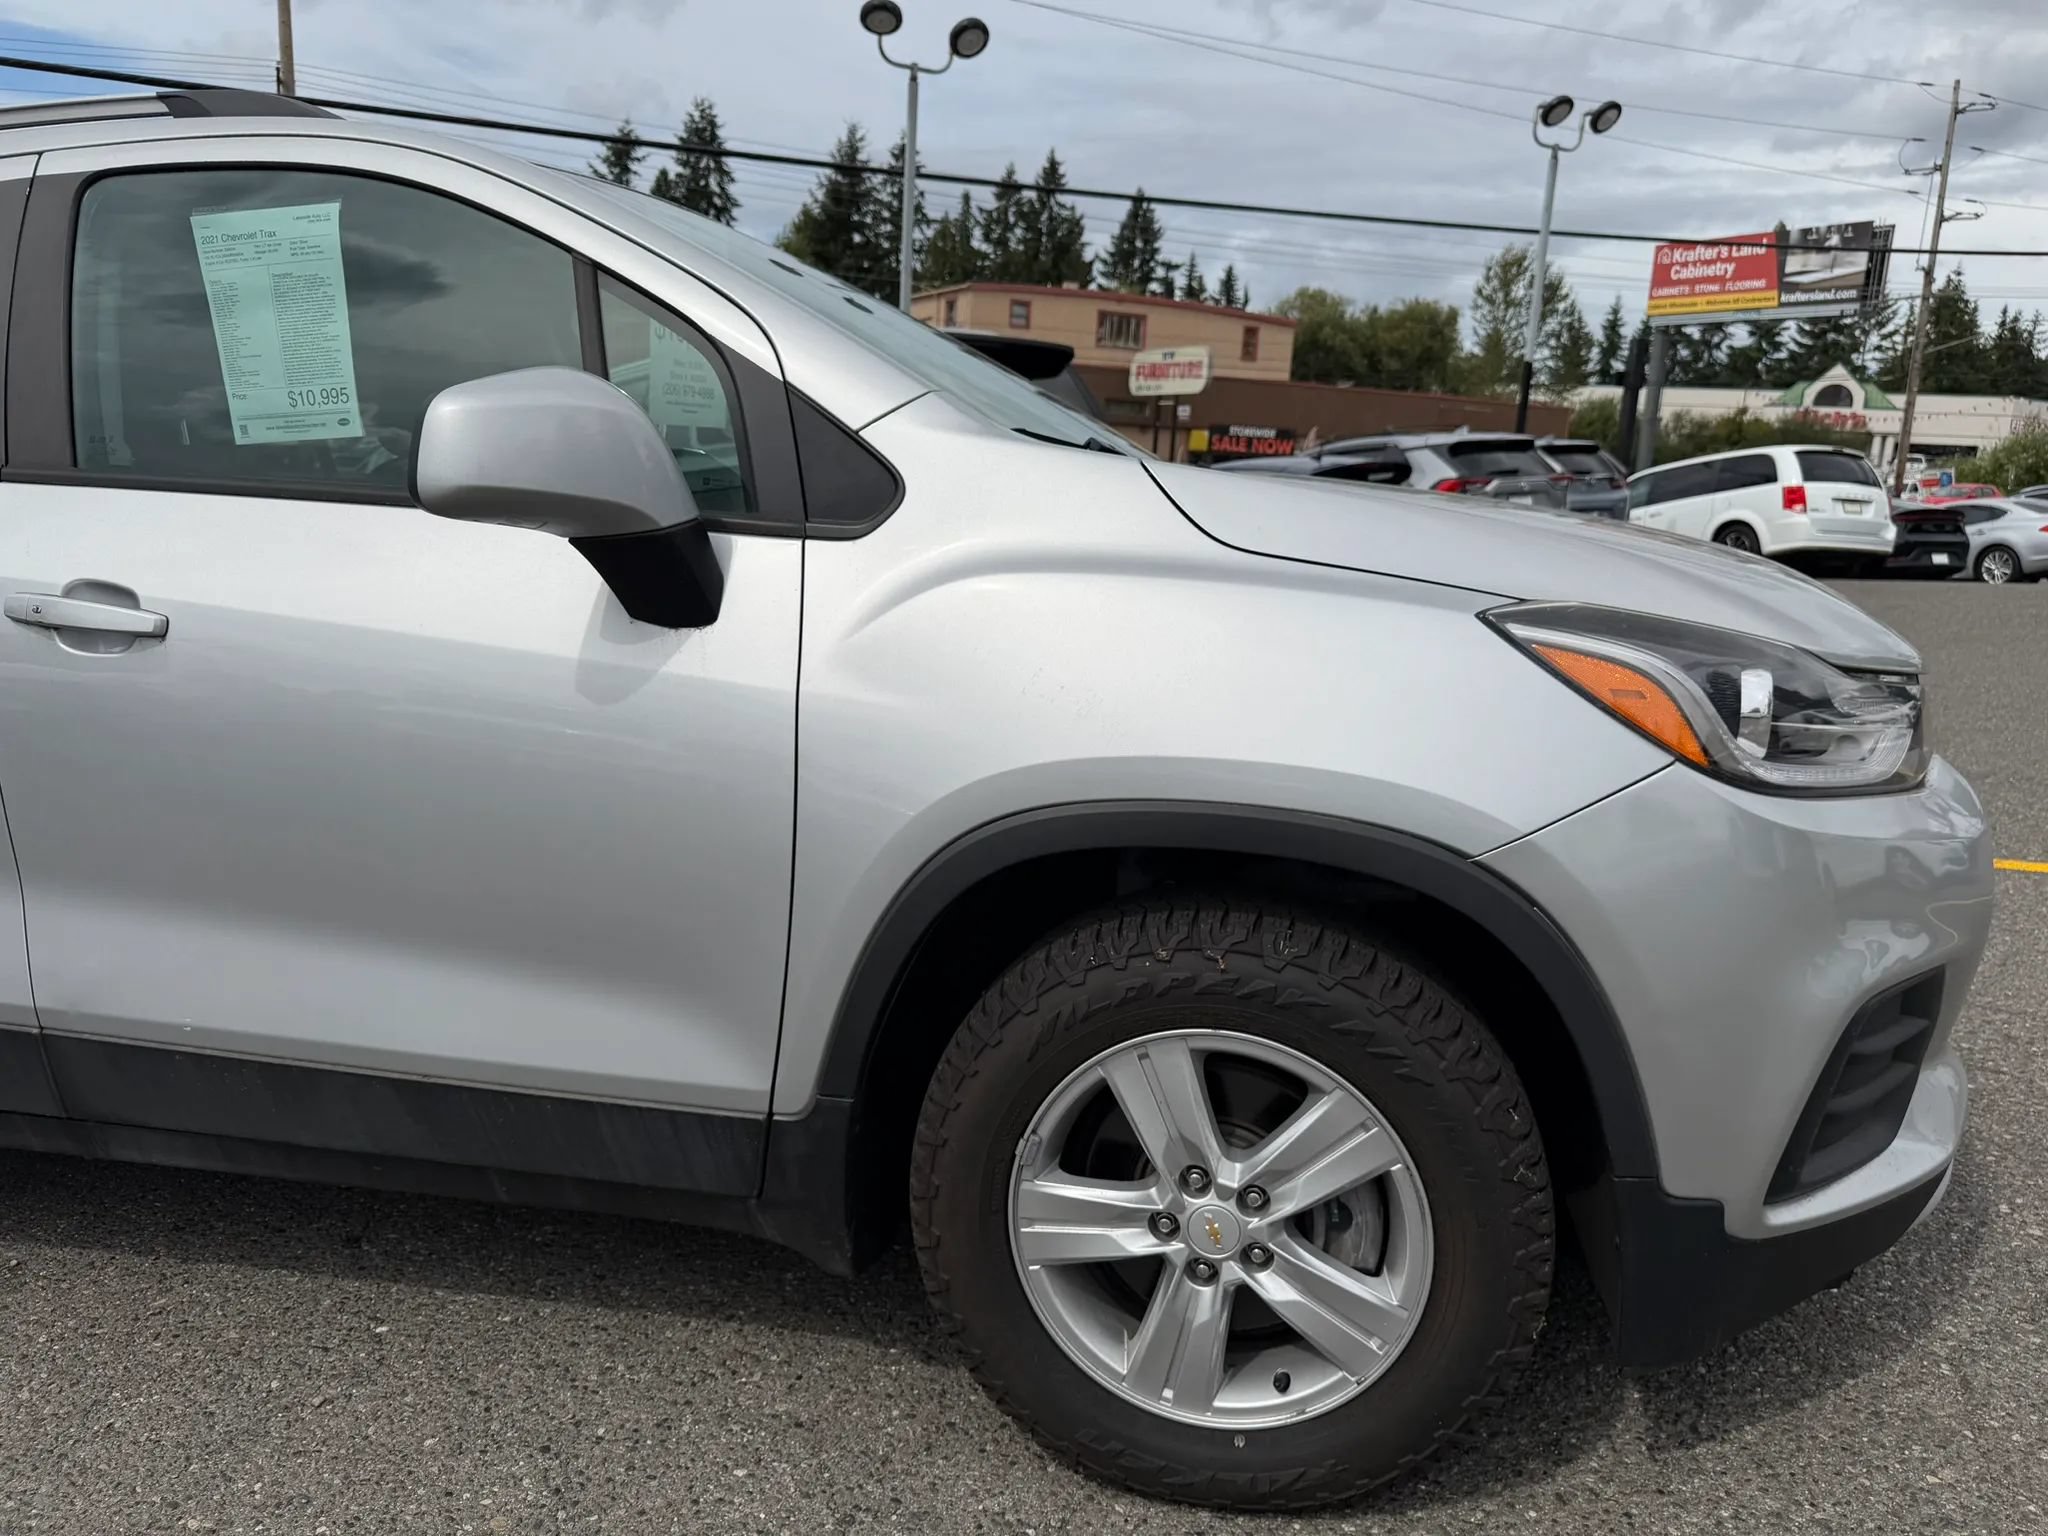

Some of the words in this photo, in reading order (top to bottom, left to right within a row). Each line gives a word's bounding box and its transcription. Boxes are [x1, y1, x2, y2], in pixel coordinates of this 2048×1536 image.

[200, 234, 219, 246] 2021
[220, 229, 258, 243] Chevrolet
[259, 228, 278, 239] Trax
[1671, 243, 1729, 264] Krafter's
[1731, 237, 1768, 258] Land
[1669, 260, 1737, 280] Cabinetry
[1693, 282, 1721, 295] STONE
[1724, 278, 1768, 292] FLOORING
[1780, 287, 1858, 303] kraftersland.com
[1135, 359, 1204, 381] FURNITURE
[231, 392, 248, 401] Price:
[287, 387, 350, 409] $10,995
[1211, 435, 1248, 451] SALE
[1252, 438, 1295, 454] NOW
